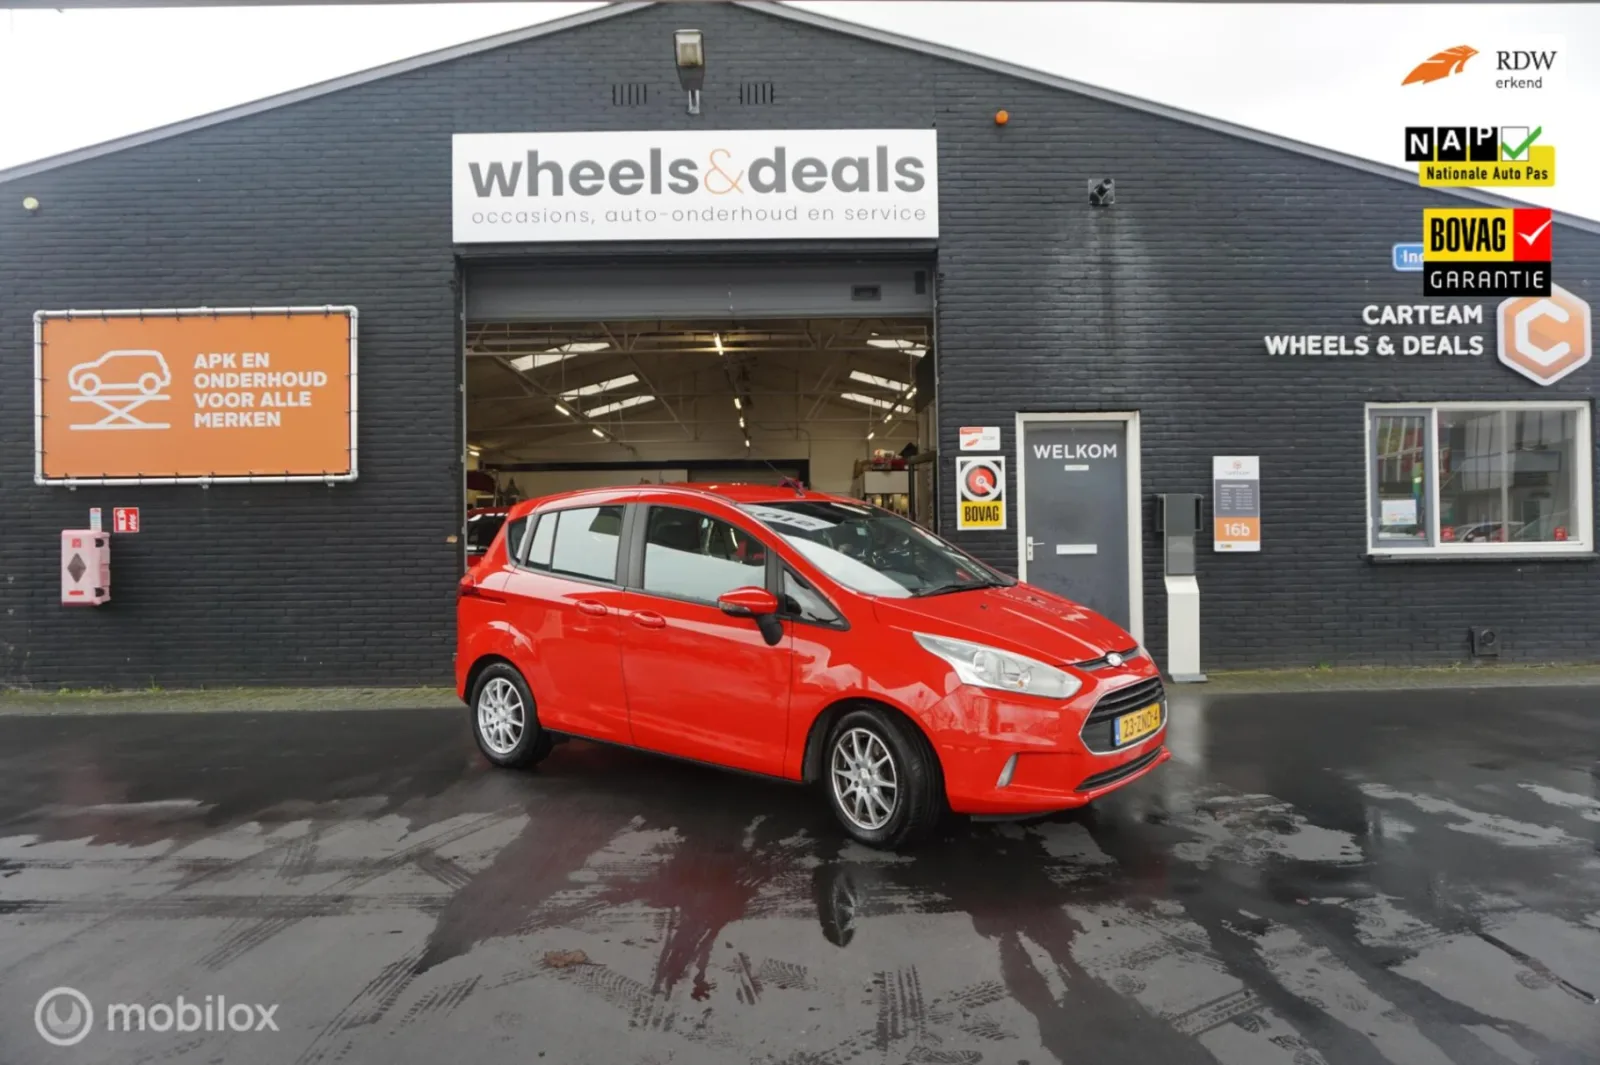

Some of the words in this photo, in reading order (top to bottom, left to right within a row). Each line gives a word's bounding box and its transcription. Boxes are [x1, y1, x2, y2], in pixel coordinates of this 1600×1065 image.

[471, 207, 597, 226] occasions,
[604, 205, 799, 224] auto-onderhoud
[807, 207, 835, 222] en
[844, 204, 927, 222] service
[1362, 304, 1483, 326] CARTEAM
[1263, 334, 1370, 357] WHEELS
[1376, 334, 1396, 357] &
[1402, 334, 1484, 356] DEALS
[193, 353, 238, 370] APK
[242, 352, 270, 369] EN
[193, 371, 328, 389] ONDERHOUD
[194, 391, 256, 409] VOOR
[260, 391, 312, 408] ALLE
[194, 411, 282, 429] MERKEN
[1032, 443, 1118, 460] WELKOM
[964, 505, 1000, 523] BOVAG
[1223, 522, 1251, 538] 16b
